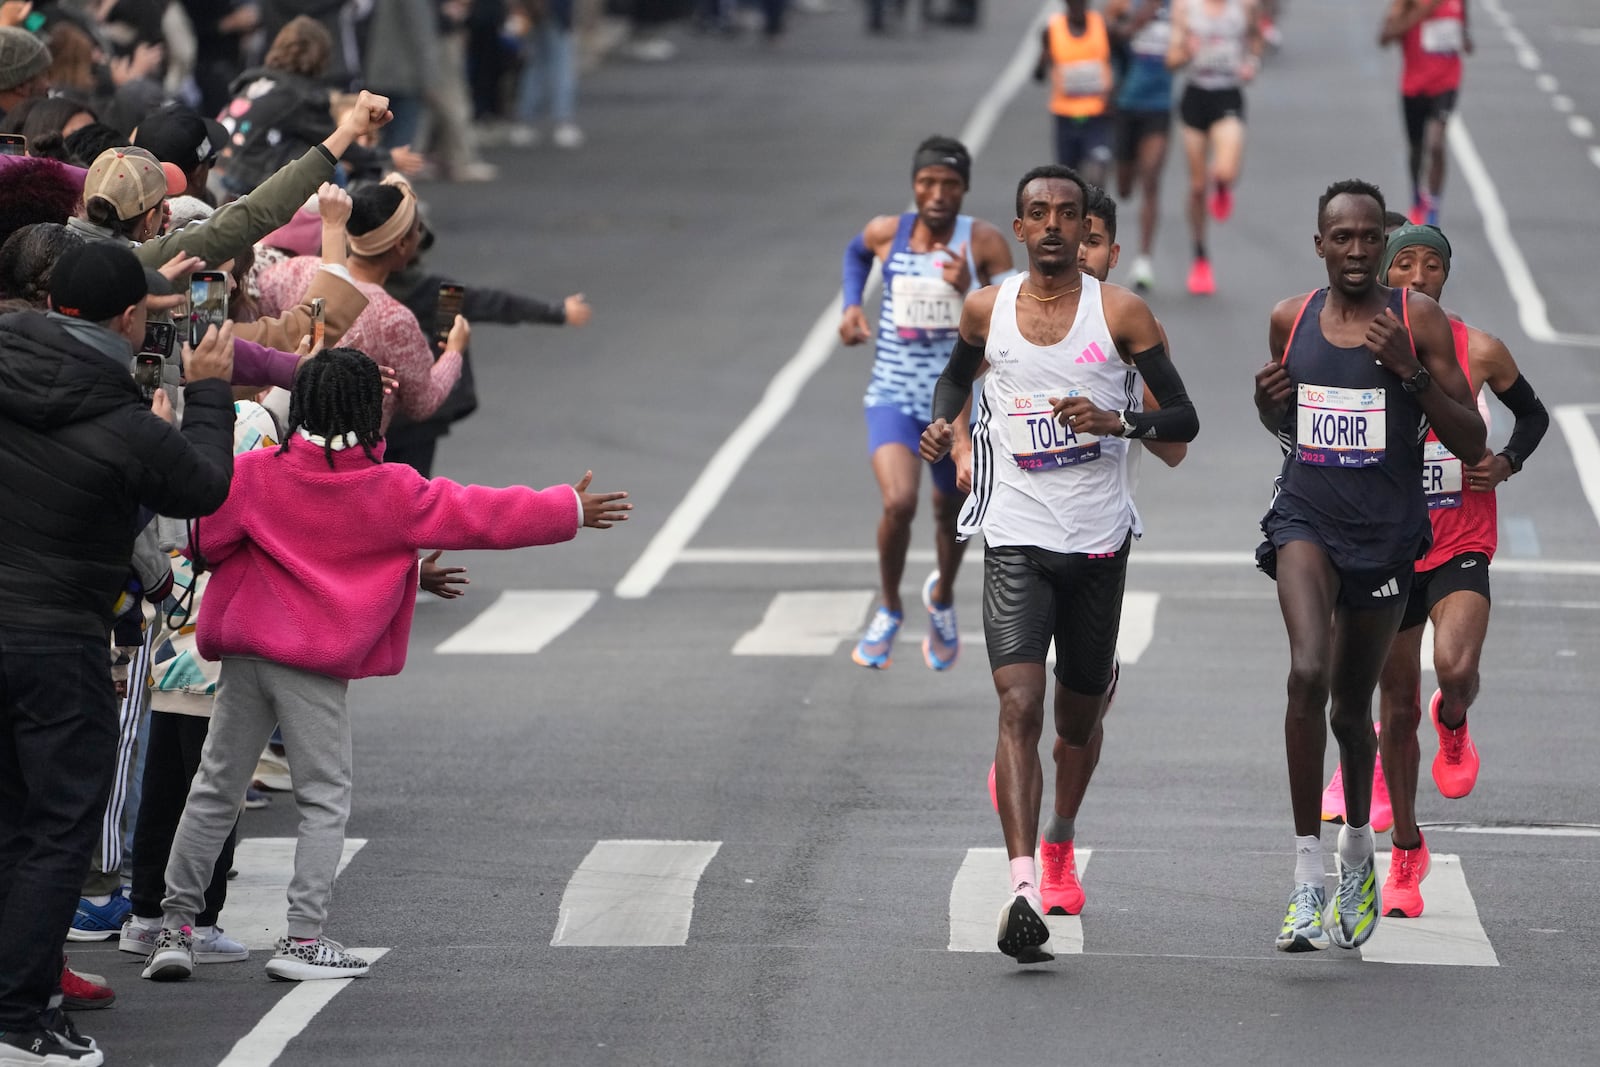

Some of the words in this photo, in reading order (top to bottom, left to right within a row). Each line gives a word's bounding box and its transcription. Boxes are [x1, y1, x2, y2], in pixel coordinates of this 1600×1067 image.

[1307, 389, 1325, 403] tcs
[1026, 416, 1078, 450] TOLA
[1312, 412, 1368, 447] KORIR
[1302, 451, 1326, 464] 2023
